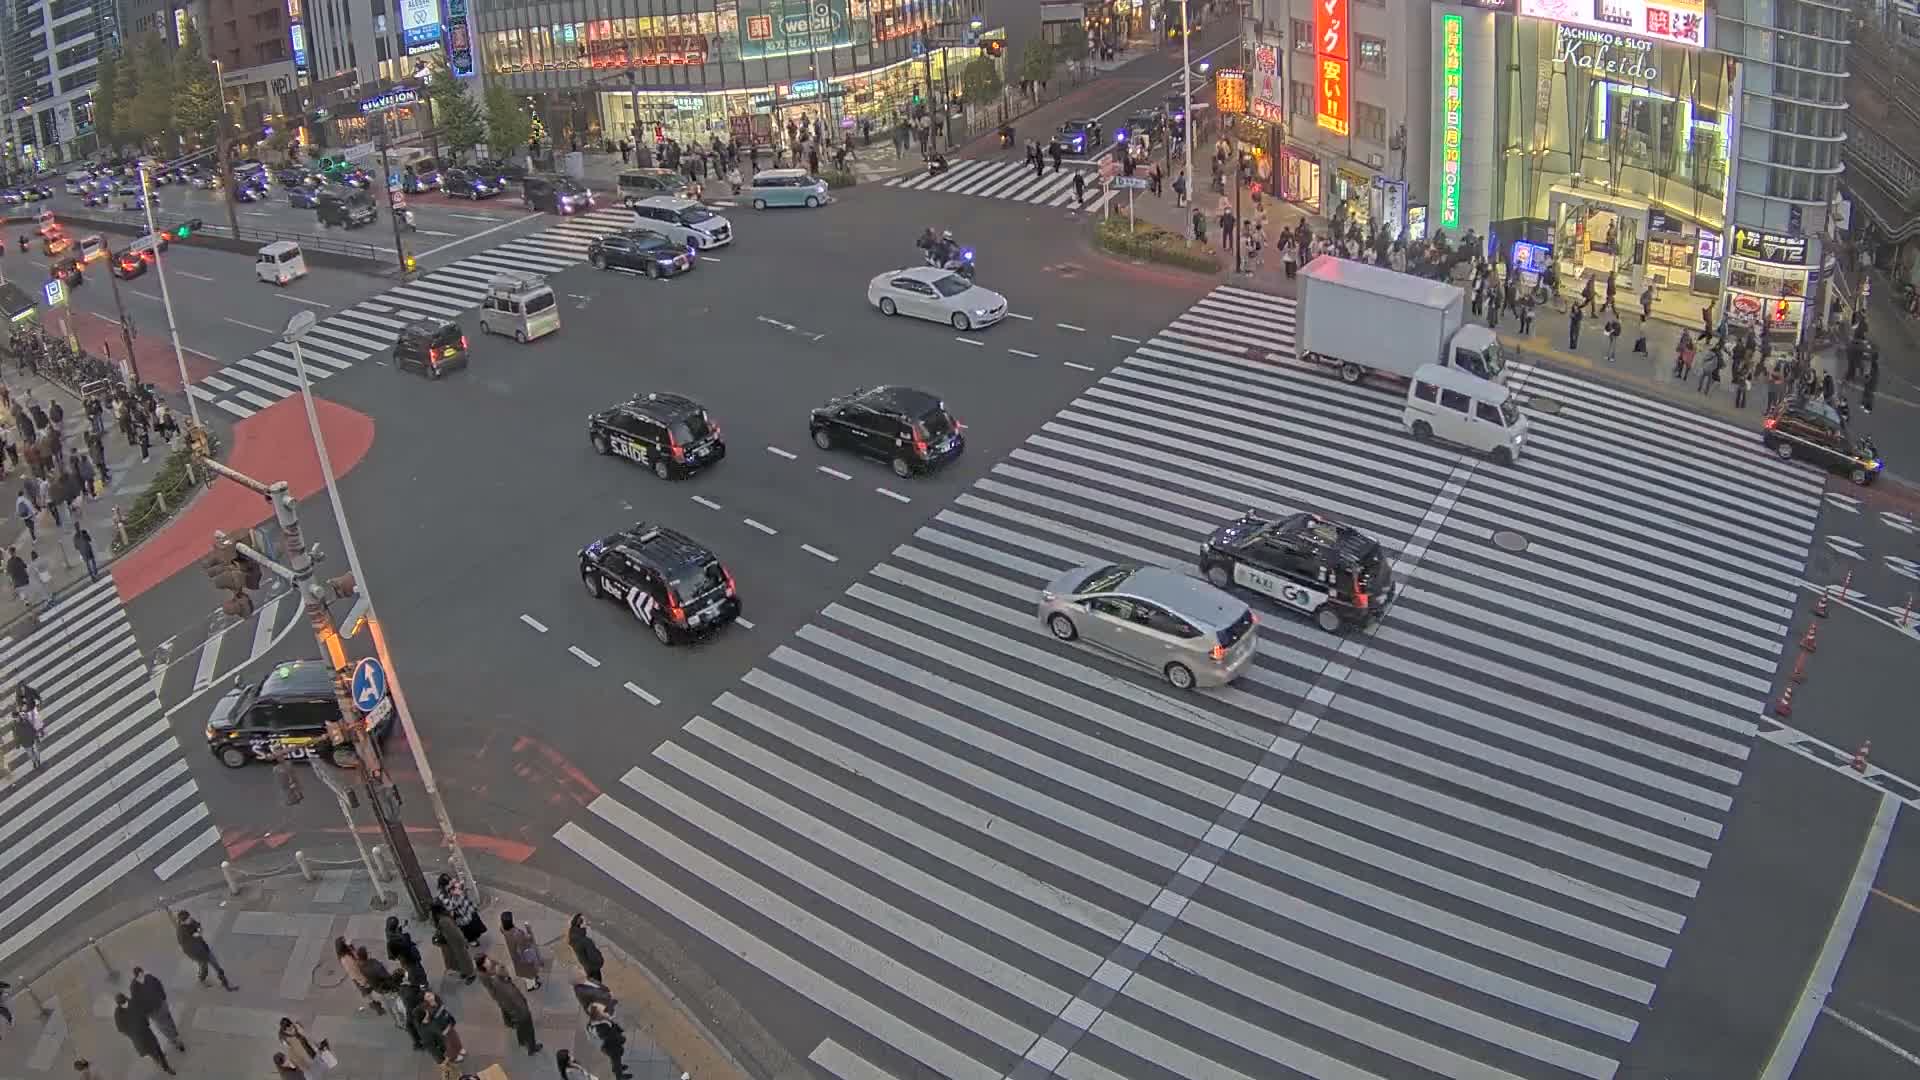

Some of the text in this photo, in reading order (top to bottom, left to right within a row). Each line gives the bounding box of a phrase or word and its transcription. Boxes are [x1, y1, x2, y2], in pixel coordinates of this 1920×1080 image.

[1558, 26, 1653, 51] PACHINKO & SLOT
[1552, 38, 1658, 80] Kaleido
[1323, 61, 1341, 117] 安い!!
[610, 440, 650, 466] S.RIDE
[1249, 571, 1273, 589] TAXI
[1283, 585, 1310, 605] GO
